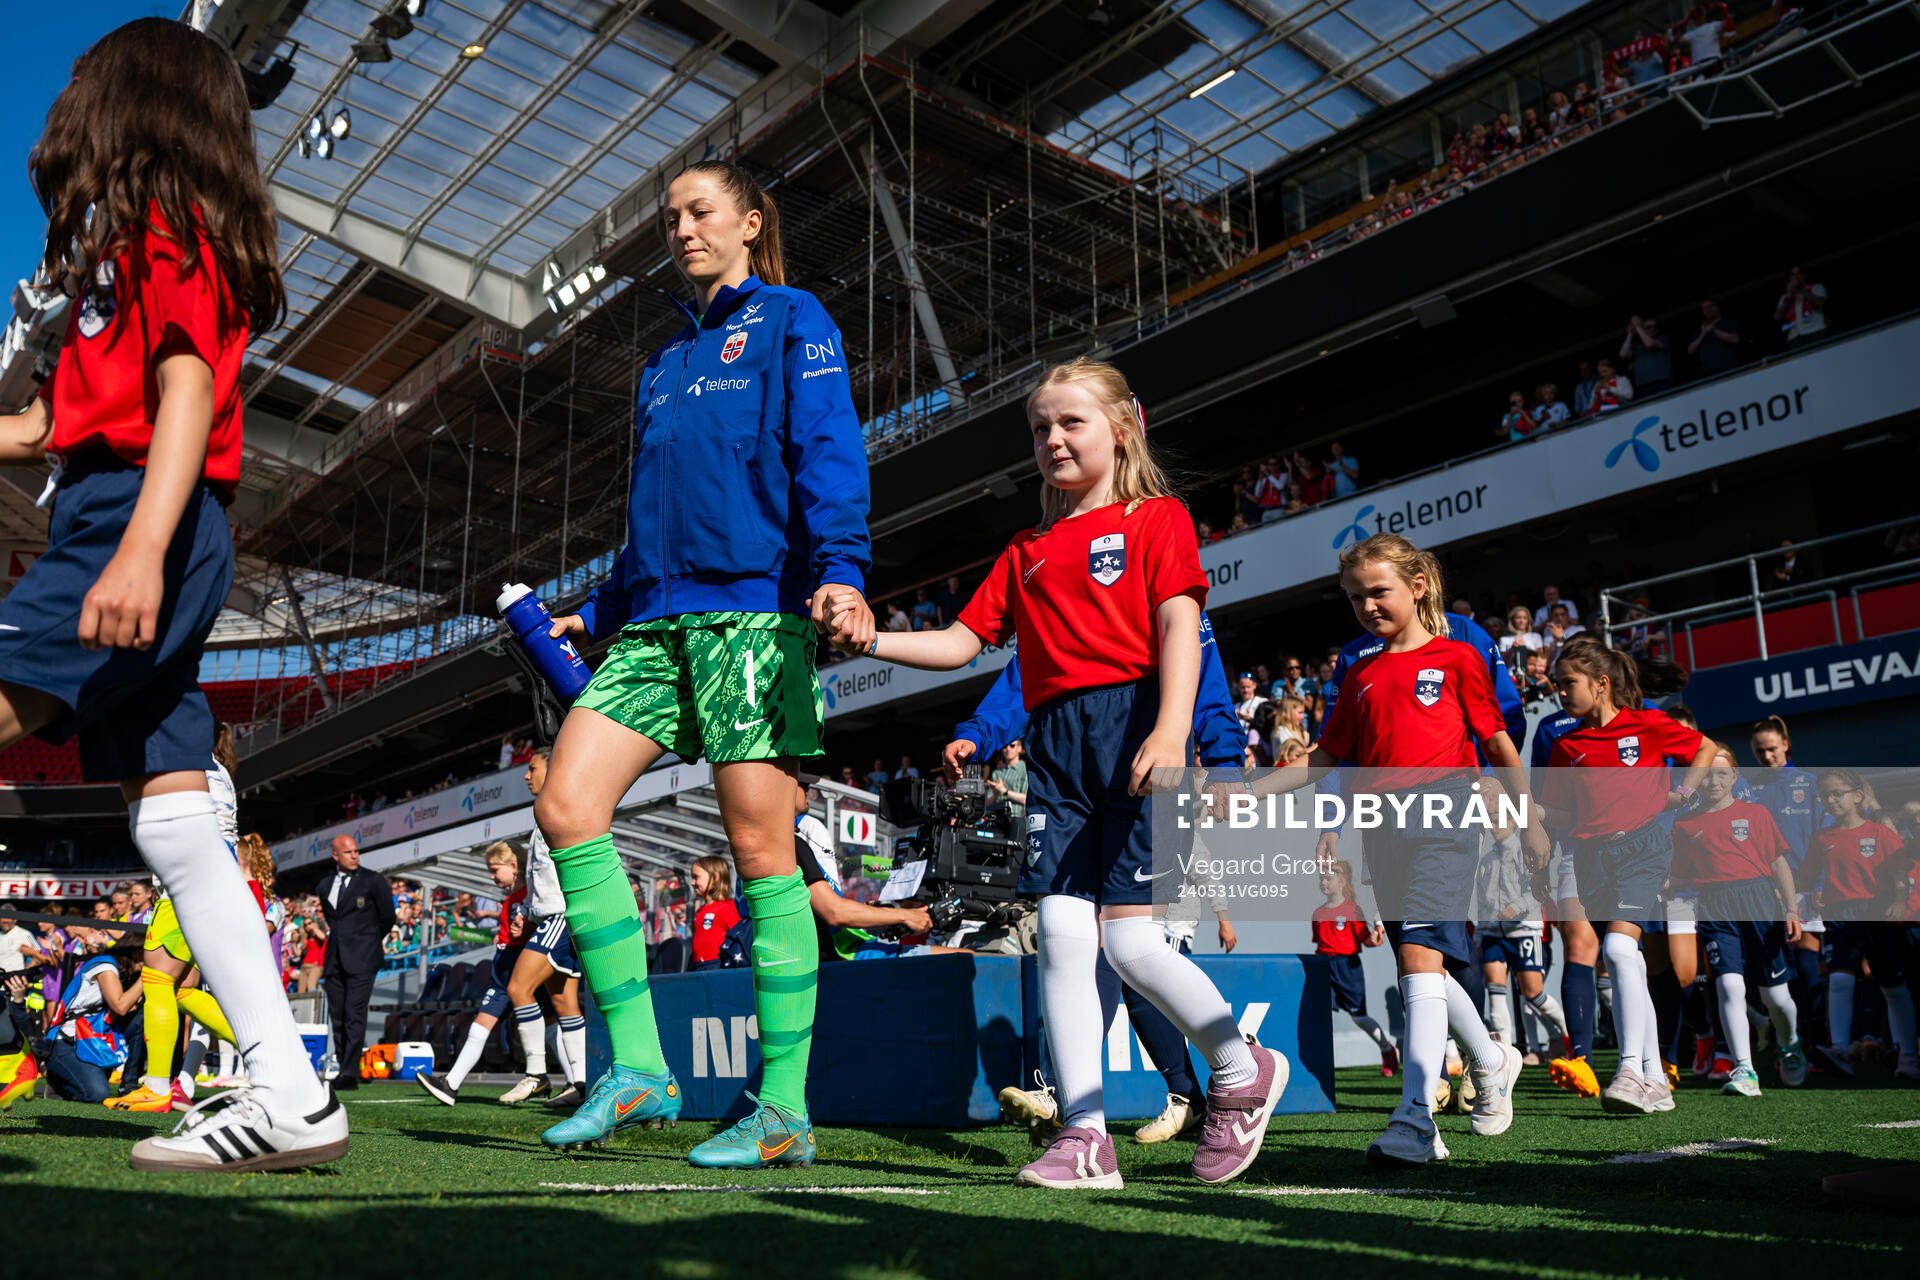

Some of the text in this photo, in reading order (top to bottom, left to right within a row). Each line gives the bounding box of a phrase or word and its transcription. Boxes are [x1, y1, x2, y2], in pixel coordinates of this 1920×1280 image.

[706, 377, 751, 391] telenor
[1660, 385, 1810, 453] telenor
[1374, 484, 1489, 535] telenor
[743, 649, 756, 709] 1
[837, 667, 894, 698] telenor
[473, 784, 504, 806] telenor
[37, 881, 87, 896] VG
[1519, 938, 1534, 958] 19
